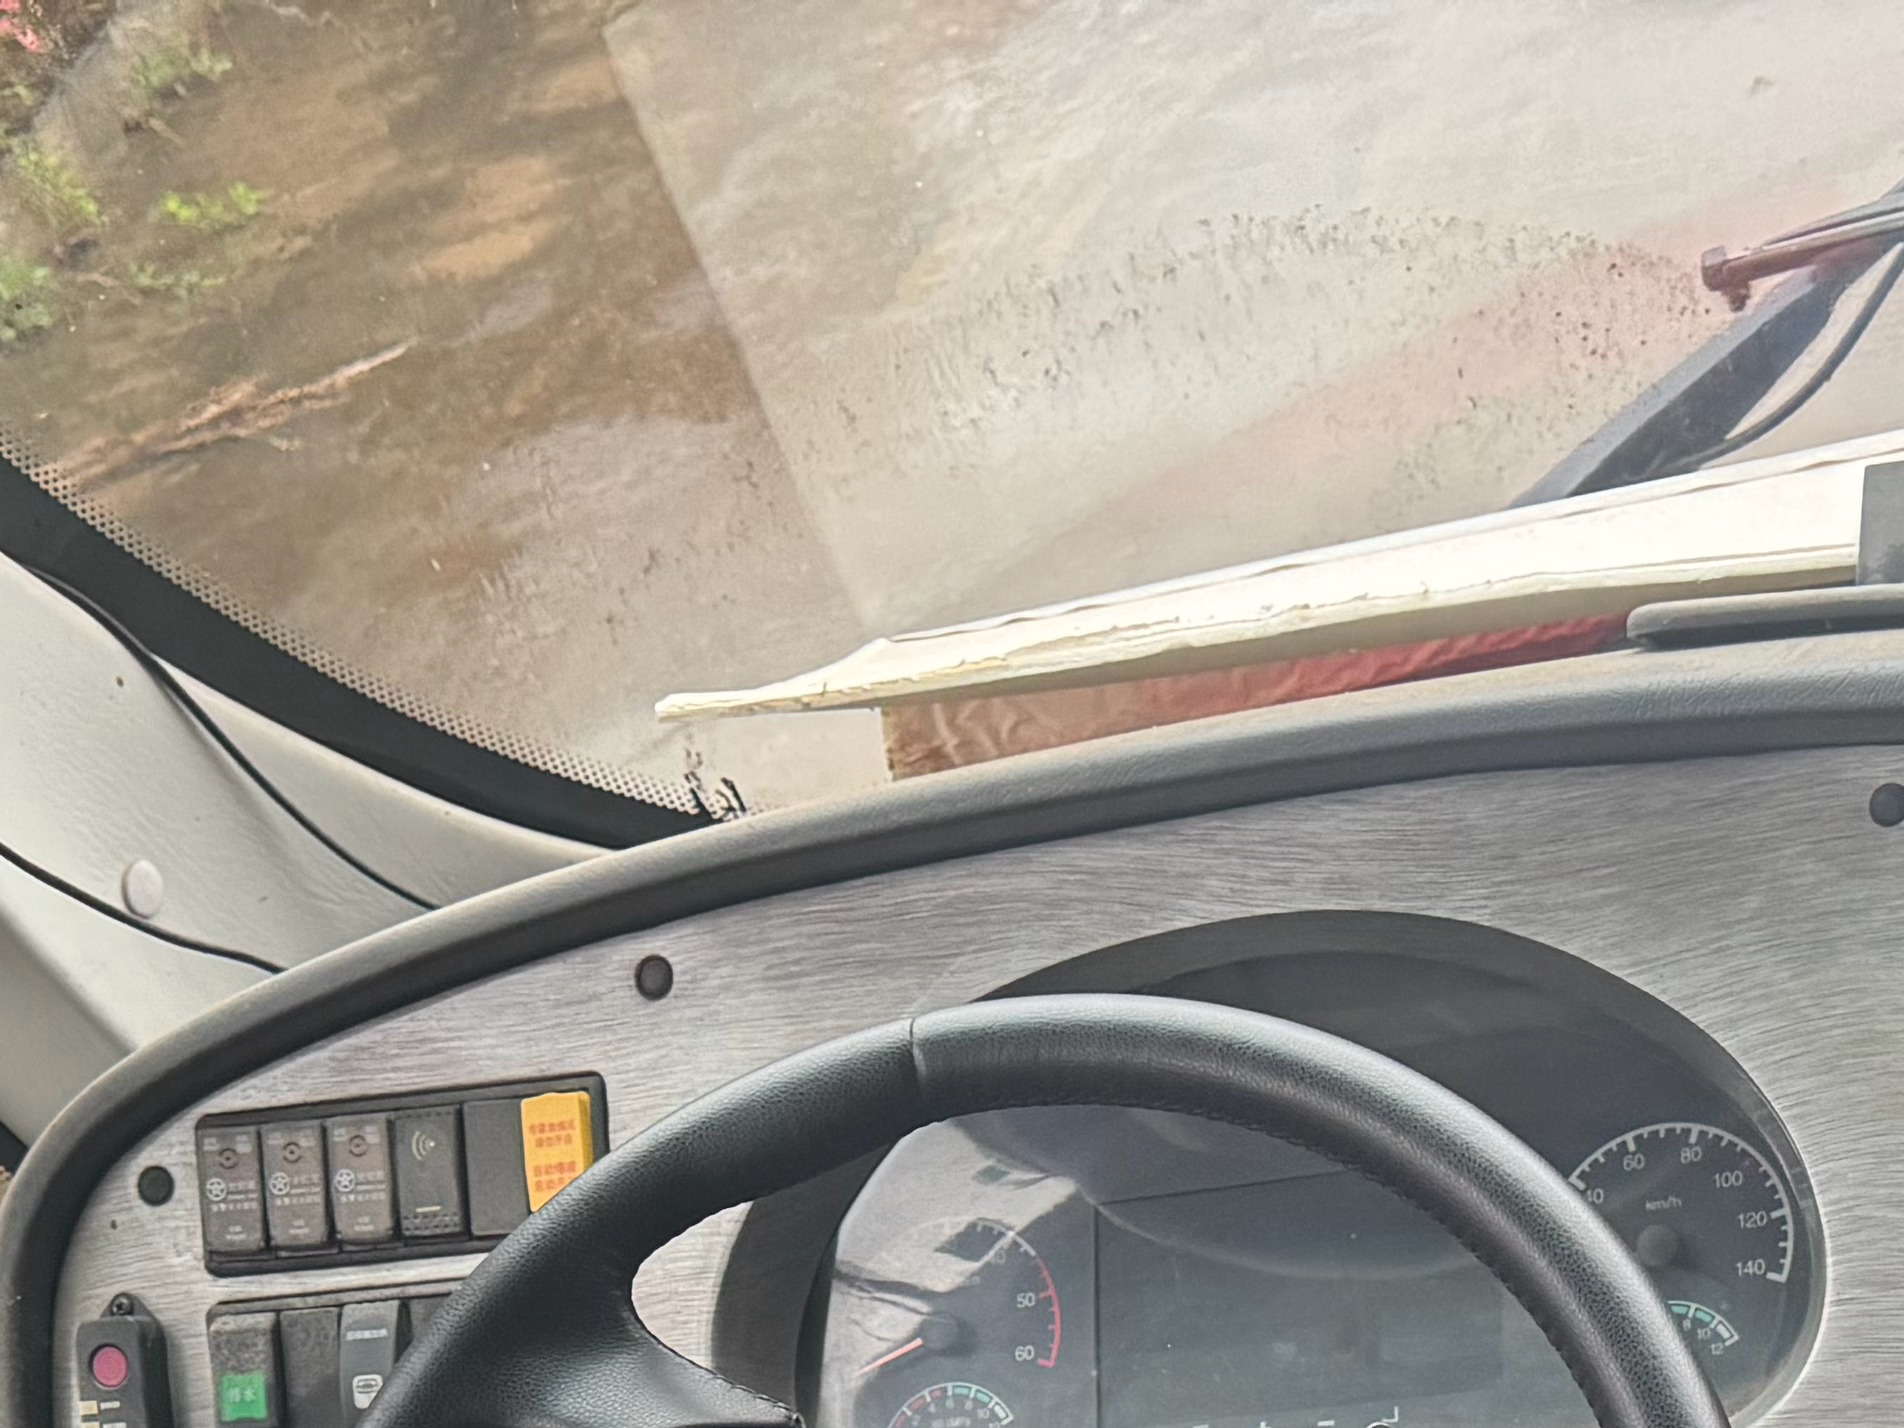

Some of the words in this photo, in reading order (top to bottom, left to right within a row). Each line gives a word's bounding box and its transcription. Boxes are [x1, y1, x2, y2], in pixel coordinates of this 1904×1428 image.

[1623, 1154, 1644, 1169] 60
[1680, 1147, 1701, 1162] 80
[1714, 1171, 1743, 1186] 100
[1645, 1196, 1682, 1209] km/h
[1737, 1211, 1767, 1227] 120
[1735, 1259, 1765, 1275] 140
[1017, 1293, 1035, 1306] 50
[1015, 1346, 1034, 1359] 60
